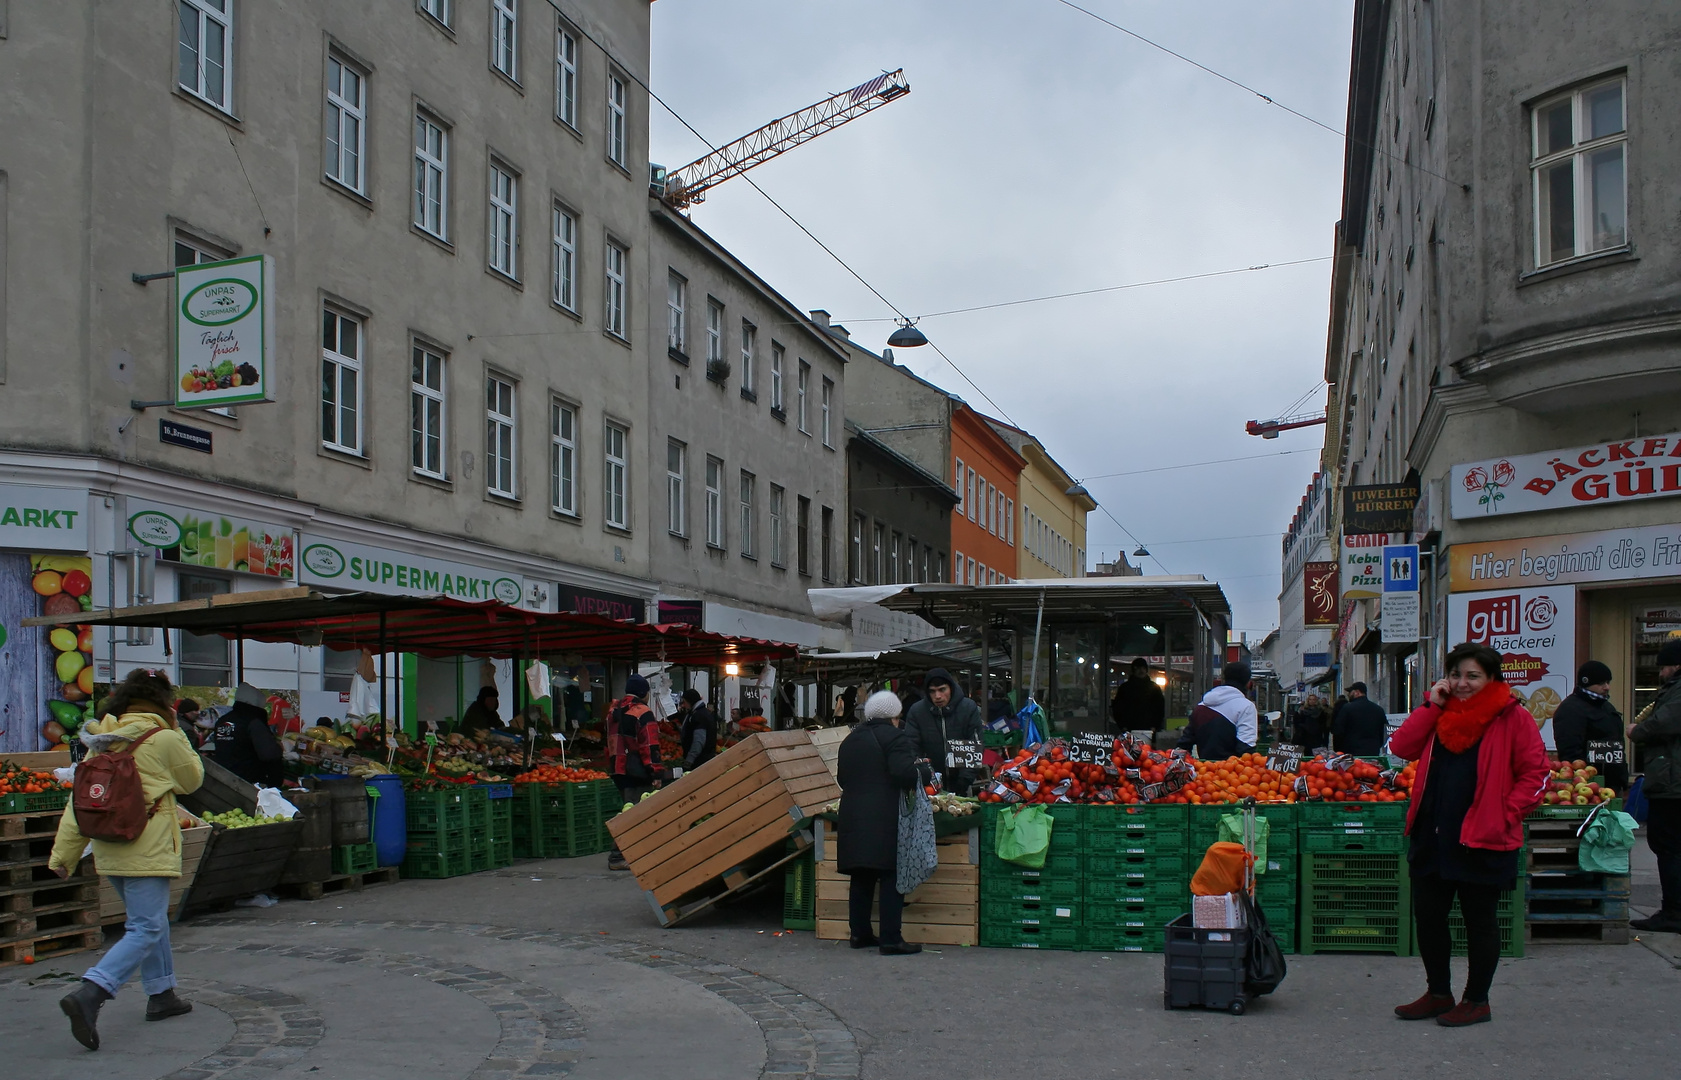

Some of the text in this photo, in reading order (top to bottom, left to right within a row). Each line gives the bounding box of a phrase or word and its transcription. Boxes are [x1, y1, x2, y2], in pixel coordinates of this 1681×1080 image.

[200, 304, 240, 318] SUPERMARKT
[201, 329, 235, 349] Täglich
[212, 341, 240, 361] frisch
[1352, 487, 1418, 502] JUWELIER
[1355, 500, 1415, 513] HÜRREM
[0, 507, 78, 530] ARKT
[1470, 552, 1515, 580] Hier
[1520, 545, 1603, 581] beginnt
[1609, 538, 1645, 569] die
[1364, 565, 1373, 575] &
[350, 557, 490, 599] SUPERMARKT
[1471, 599, 1517, 643] gül
[1493, 635, 1556, 650] bäckerei
[1501, 669, 1527, 678] mmel
[951, 745, 976, 753] PORRE
[1070, 745, 1081, 762] 2
[1081, 750, 1092, 759] KG
[1265, 756, 1276, 770] 1
